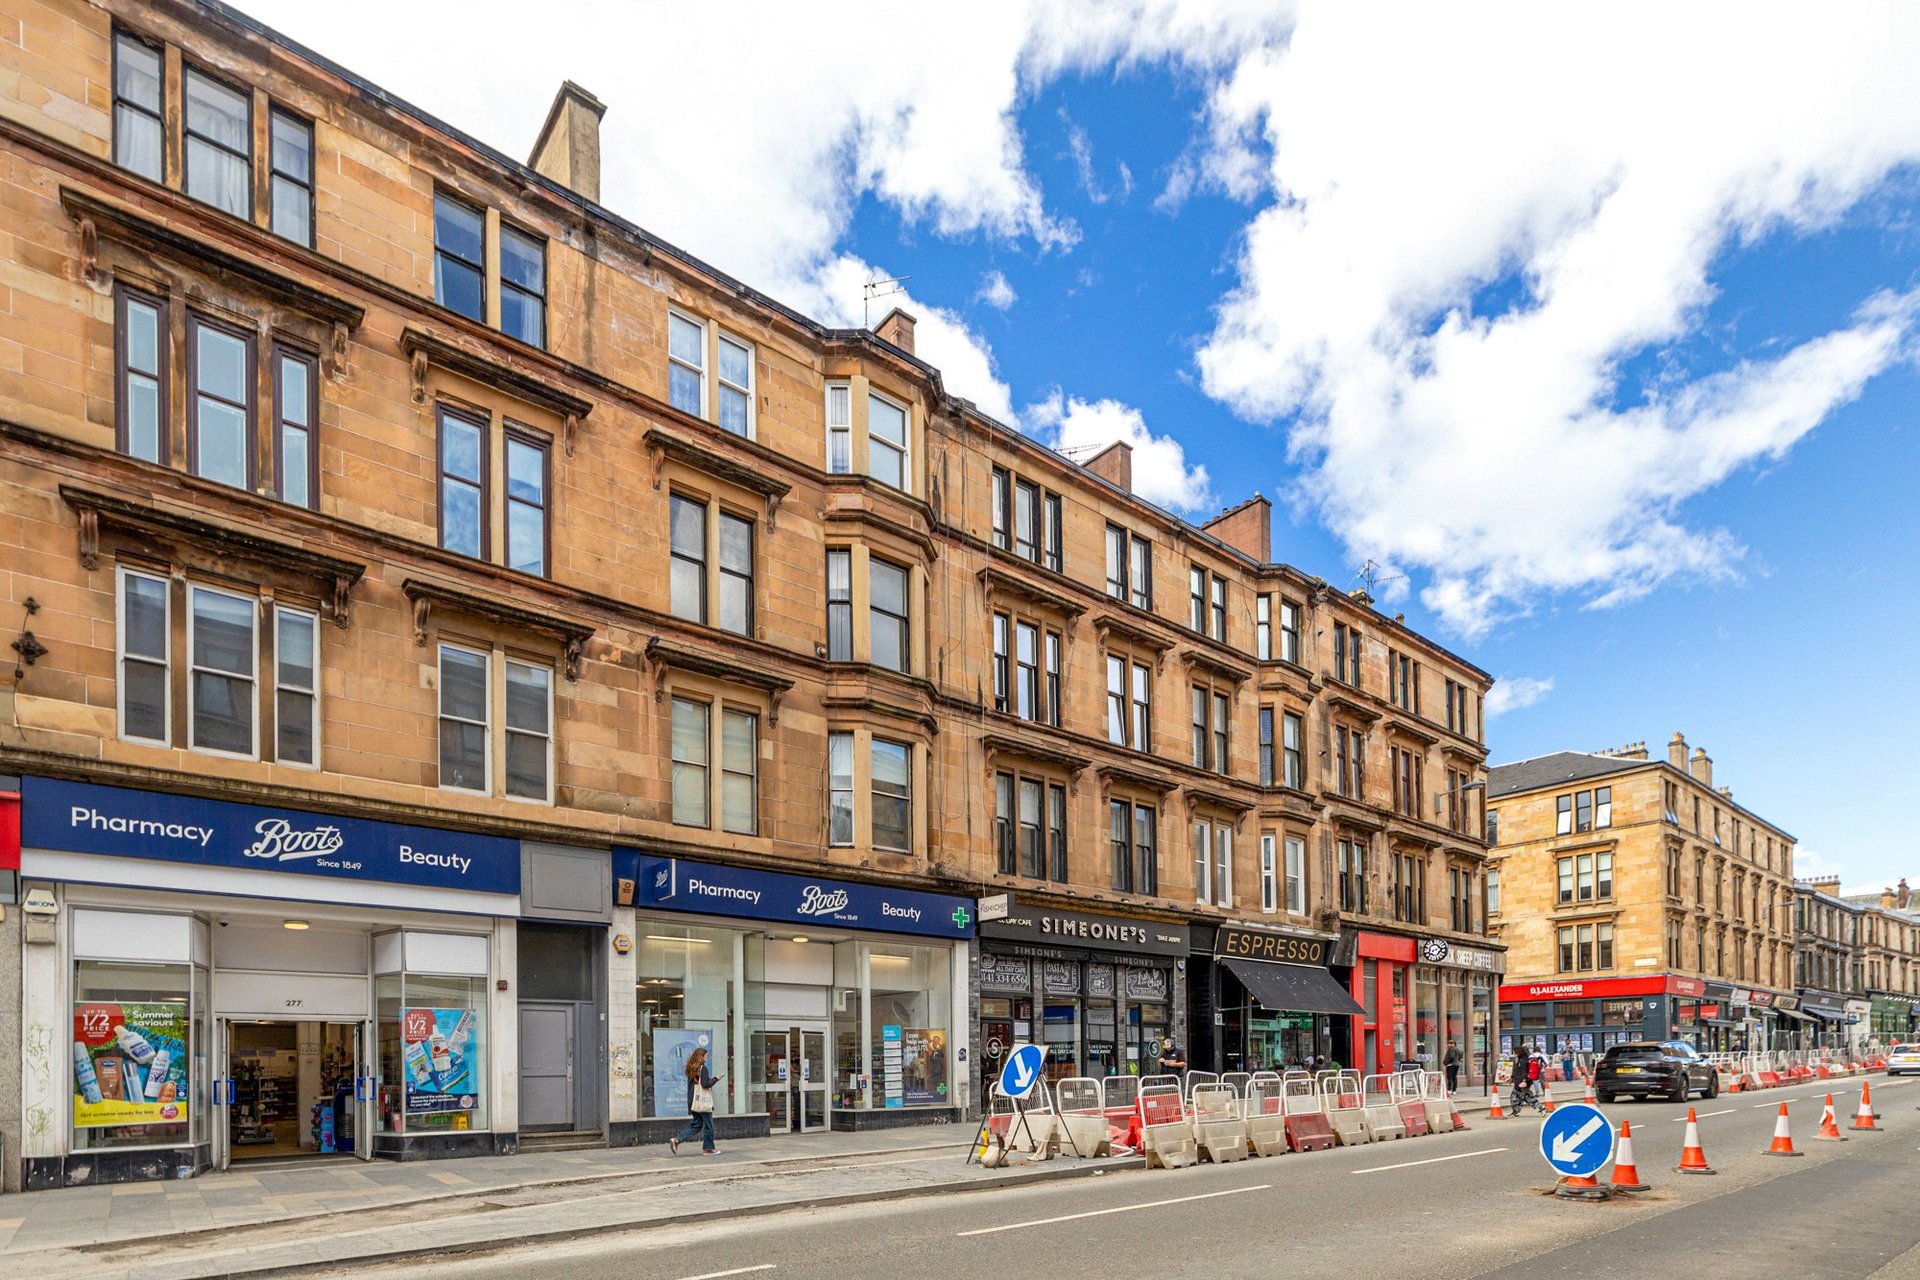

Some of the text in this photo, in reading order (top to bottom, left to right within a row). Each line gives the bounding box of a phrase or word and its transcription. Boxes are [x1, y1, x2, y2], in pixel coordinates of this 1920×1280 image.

[71, 806, 214, 847] Pharmacy
[243, 819, 344, 862] Boots
[316, 857, 362, 870] Since 1849
[399, 845, 472, 874] Beauty
[688, 878, 761, 905] Pharmacy
[797, 885, 848, 916] Boots
[833, 912, 847, 920] Since
[882, 902, 922, 922] Beauty
[1018, 918, 1032, 926] CAFE
[1042, 916, 1146, 944] SIMEONE'S
[1014, 946, 1062, 958] SIMEONE'S
[1226, 932, 1320, 961] ESPRESSO
[1115, 956, 1154, 967] SIMEONE'S
[1456, 950, 1472, 966] SHEEP
[1474, 952, 1492, 969] COFFEE
[82, 1014, 110, 1026] 1/2
[132, 1010, 174, 1019] Summer
[132, 1018, 174, 1026] saviours
[408, 1020, 426, 1030] 1/2
